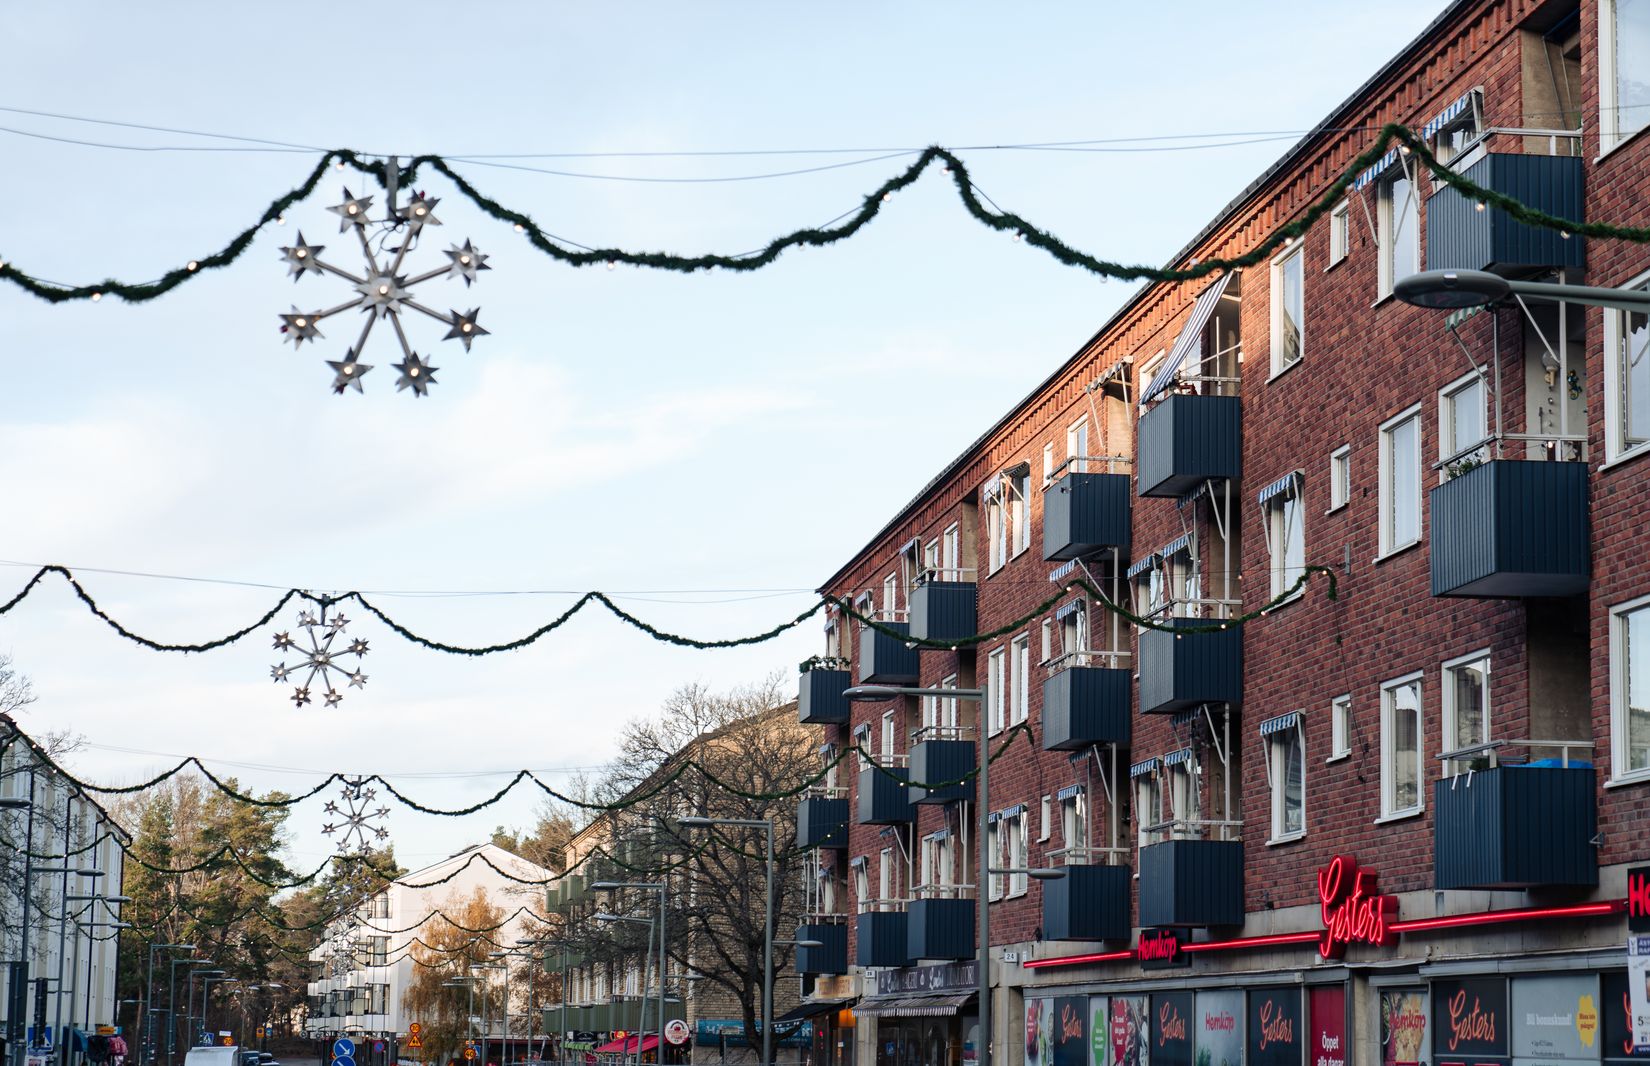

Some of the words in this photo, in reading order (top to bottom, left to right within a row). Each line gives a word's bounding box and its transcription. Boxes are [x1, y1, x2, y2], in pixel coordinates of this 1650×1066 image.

[1318, 855, 1384, 958] Gesters
[1138, 930, 1177, 963] Hemköp
[1061, 1003, 1082, 1044] Gesters
[1160, 1001, 1185, 1047] Gesters
[1205, 1010, 1235, 1034] Hemköp
[1260, 999, 1293, 1051] Gesters
[1388, 1009, 1426, 1030] Hemköp
[1449, 989, 1495, 1051] Gesters
[1321, 1031, 1339, 1052] Öppet
